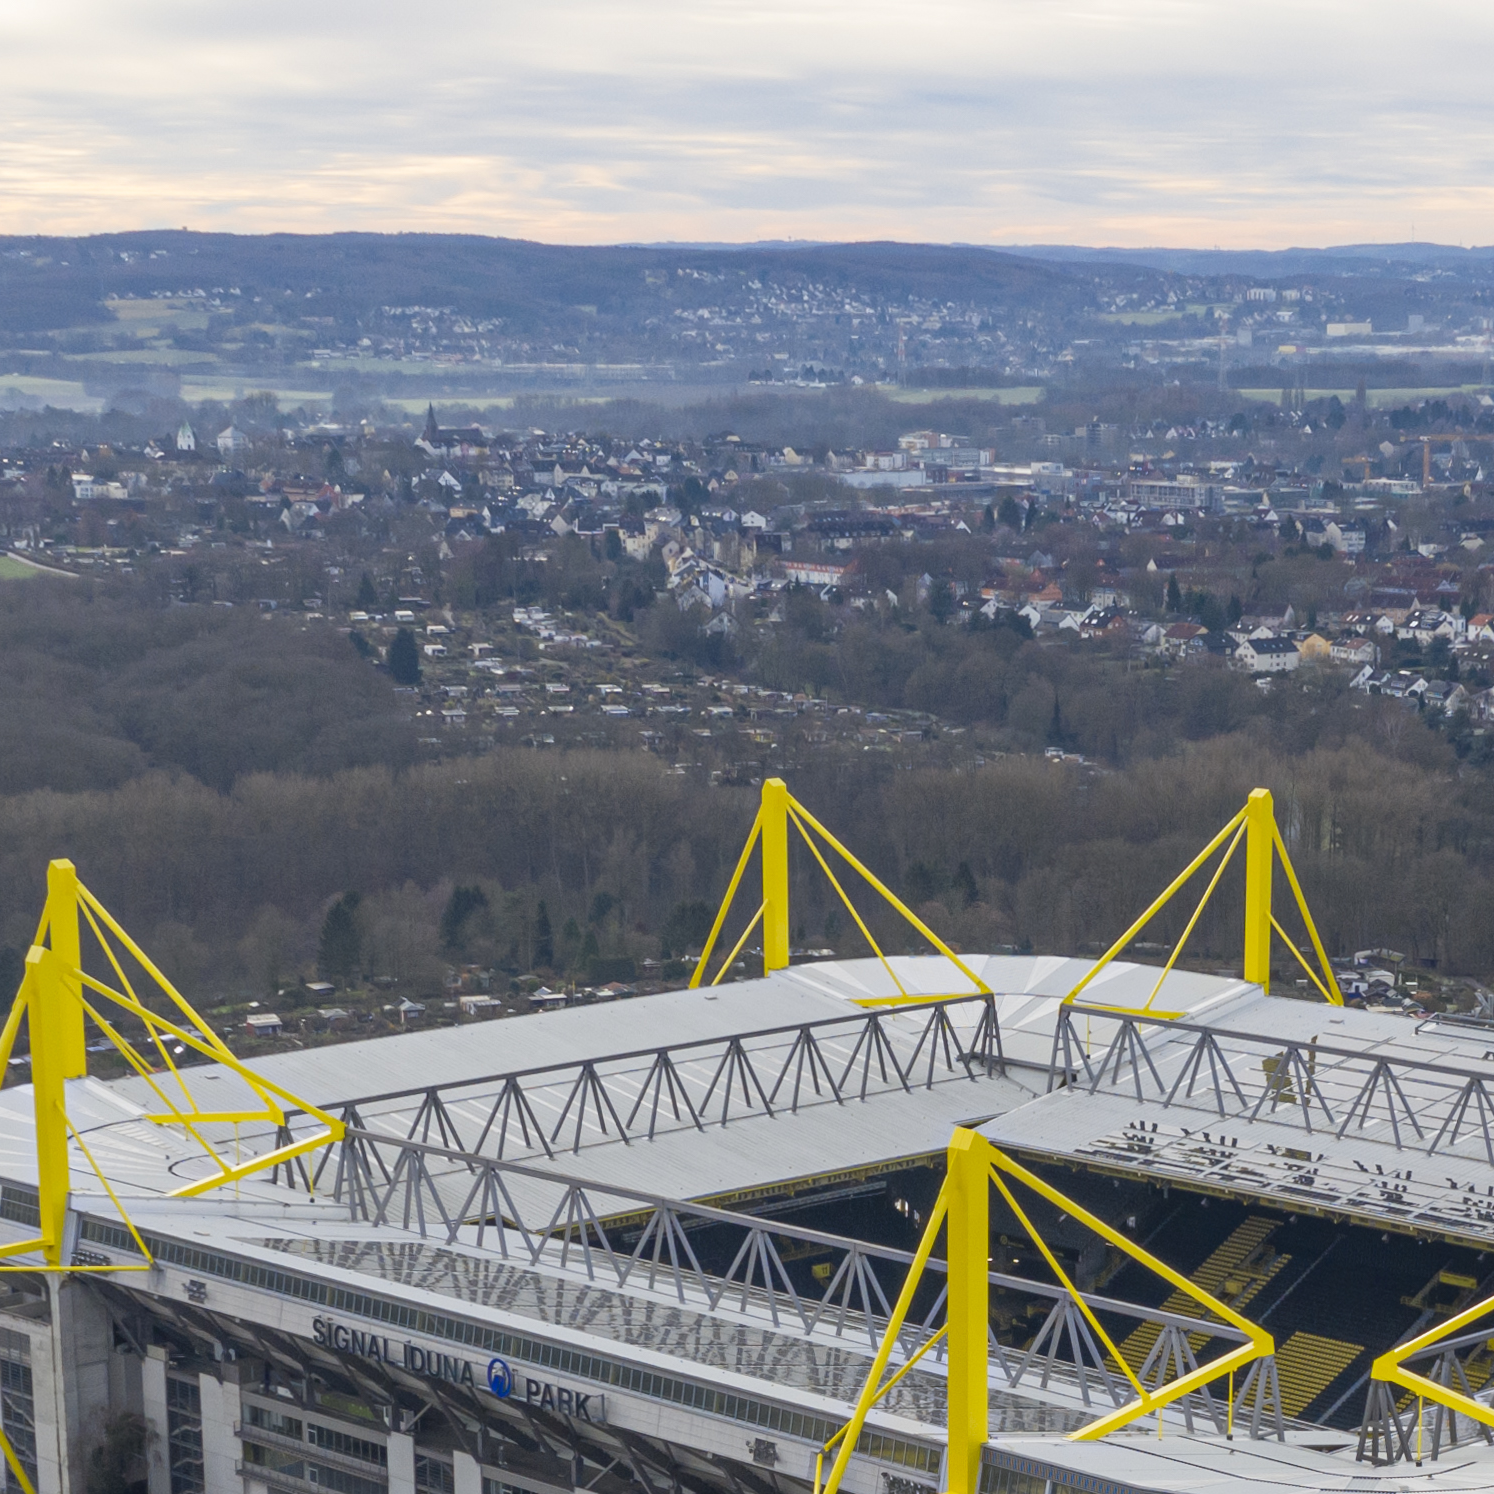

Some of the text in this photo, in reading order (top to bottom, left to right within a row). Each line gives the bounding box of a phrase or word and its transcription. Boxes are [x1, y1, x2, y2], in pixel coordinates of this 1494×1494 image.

[312, 1317, 592, 1422] SIGNAL IDUNA PARK
